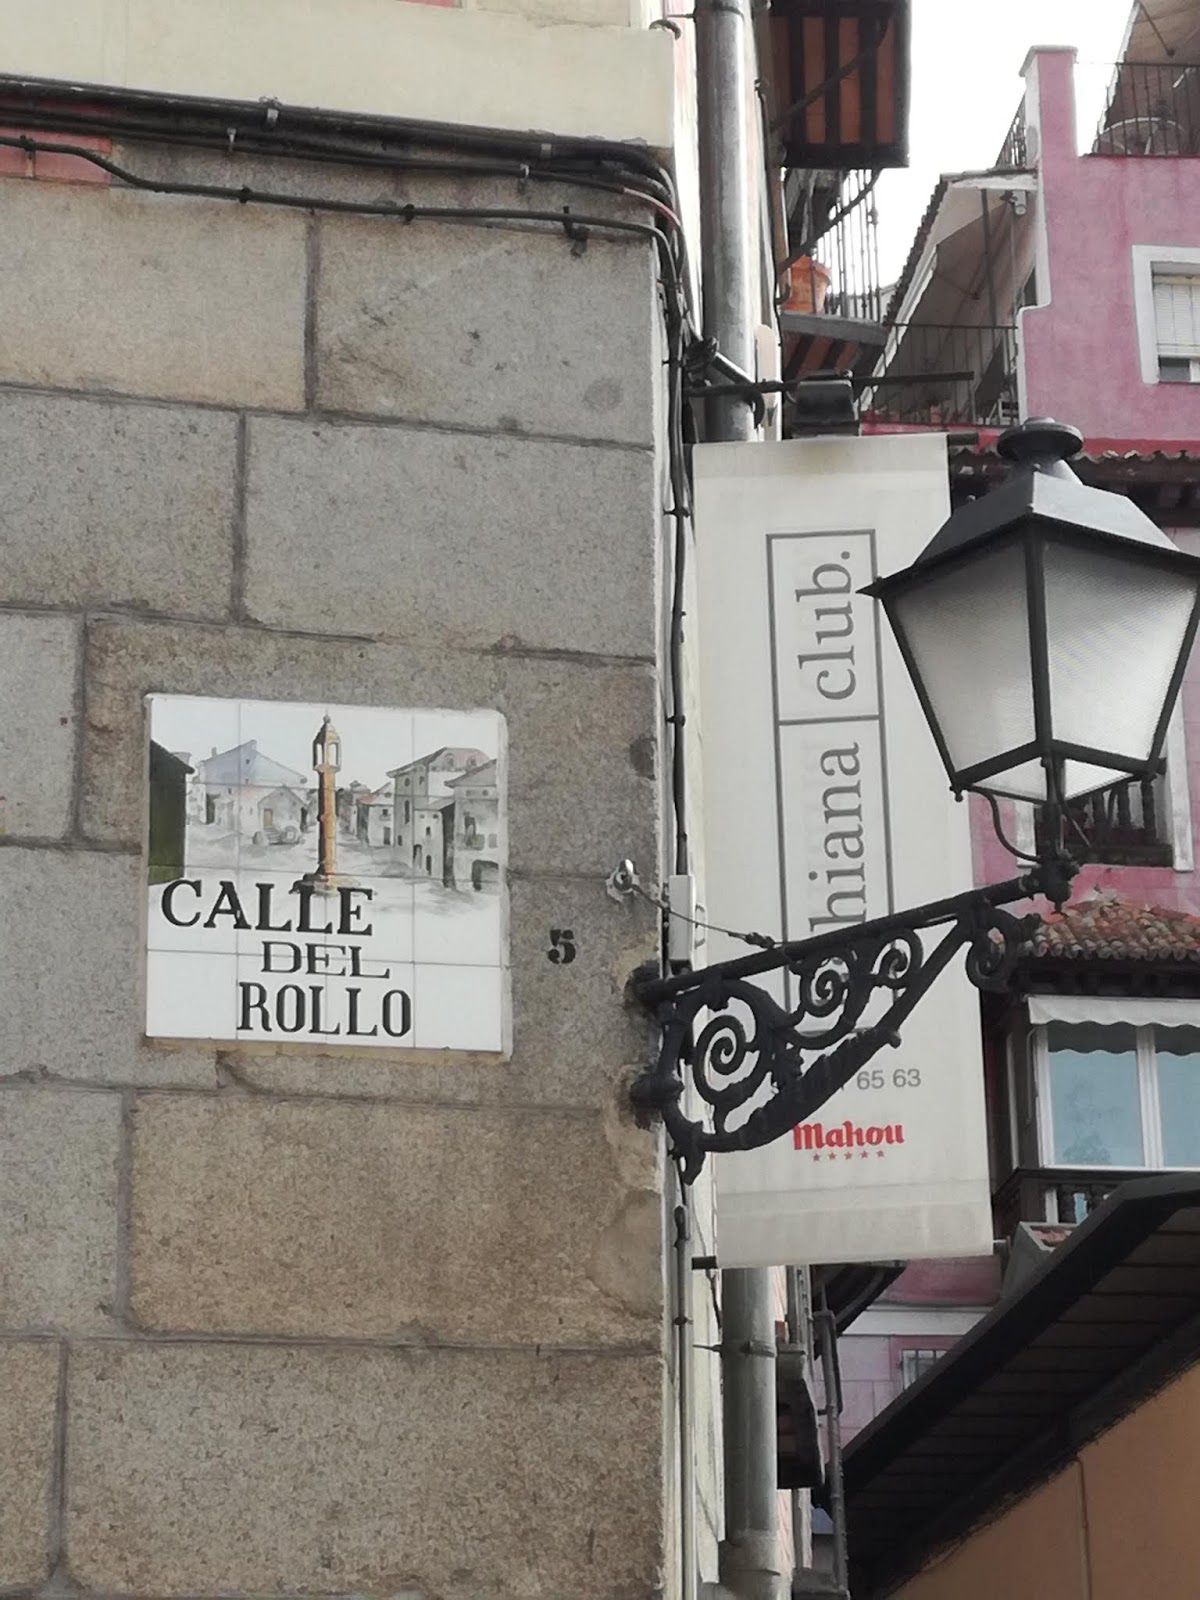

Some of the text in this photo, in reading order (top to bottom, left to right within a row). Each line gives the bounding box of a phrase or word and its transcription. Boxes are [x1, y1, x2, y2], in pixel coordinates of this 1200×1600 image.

[795, 550, 871, 1005] hiana club.
[161, 879, 373, 936] CALLE
[261, 940, 390, 979] DEL
[547, 928, 577, 965] 5
[236, 981, 411, 1037] ROLLO
[856, 1070, 885, 1090] 65
[892, 1068, 922, 1088] 63
[793, 1120, 905, 1150] Mahou
